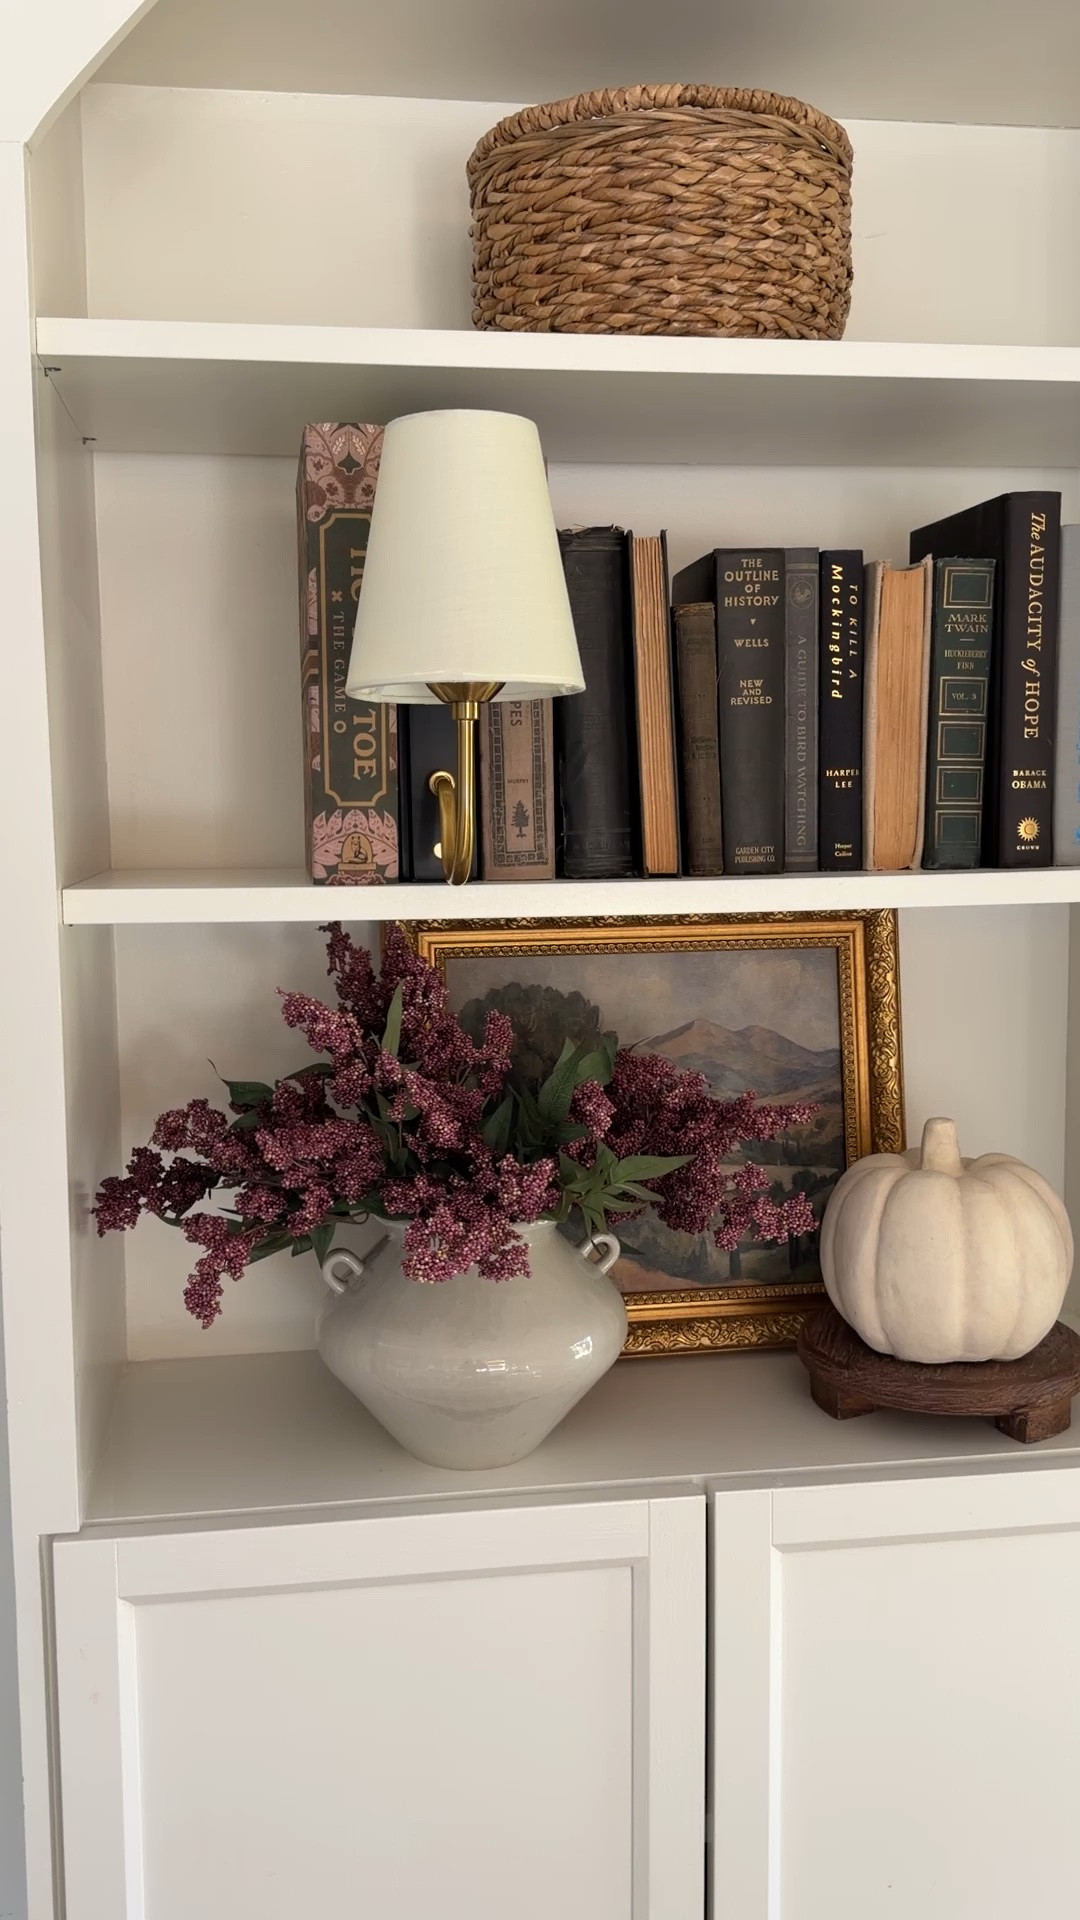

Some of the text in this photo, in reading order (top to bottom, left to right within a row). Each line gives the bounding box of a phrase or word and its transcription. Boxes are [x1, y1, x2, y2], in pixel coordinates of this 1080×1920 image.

[741, 558, 763, 568] THE
[724, 570, 779, 583] OUTLINE
[744, 584, 761, 594] OF
[724, 596, 779, 607] HISTORY
[948, 613, 987, 623] MARK
[333, 611, 345, 650] THE
[944, 623, 988, 633] TWAIN
[1020, 512, 1046, 739] The AUDACITY of HOPE
[829, 564, 843, 699] Mockingbird
[849, 584, 858, 679] TO KILL A
[734, 638, 769, 647] WELLS
[333, 659, 346, 713] GAME
[740, 680, 763, 688] NEW
[742, 688, 762, 696] AND
[731, 696, 773, 705] REVISED
[353, 709, 376, 780] TOE
[797, 635, 807, 846] A GUIDE TO BIRD WATCHING
[826, 769, 859, 777] HARPER
[1011, 780, 1047, 789] OBAMA
[735, 845, 774, 855] GARDEN CITY
